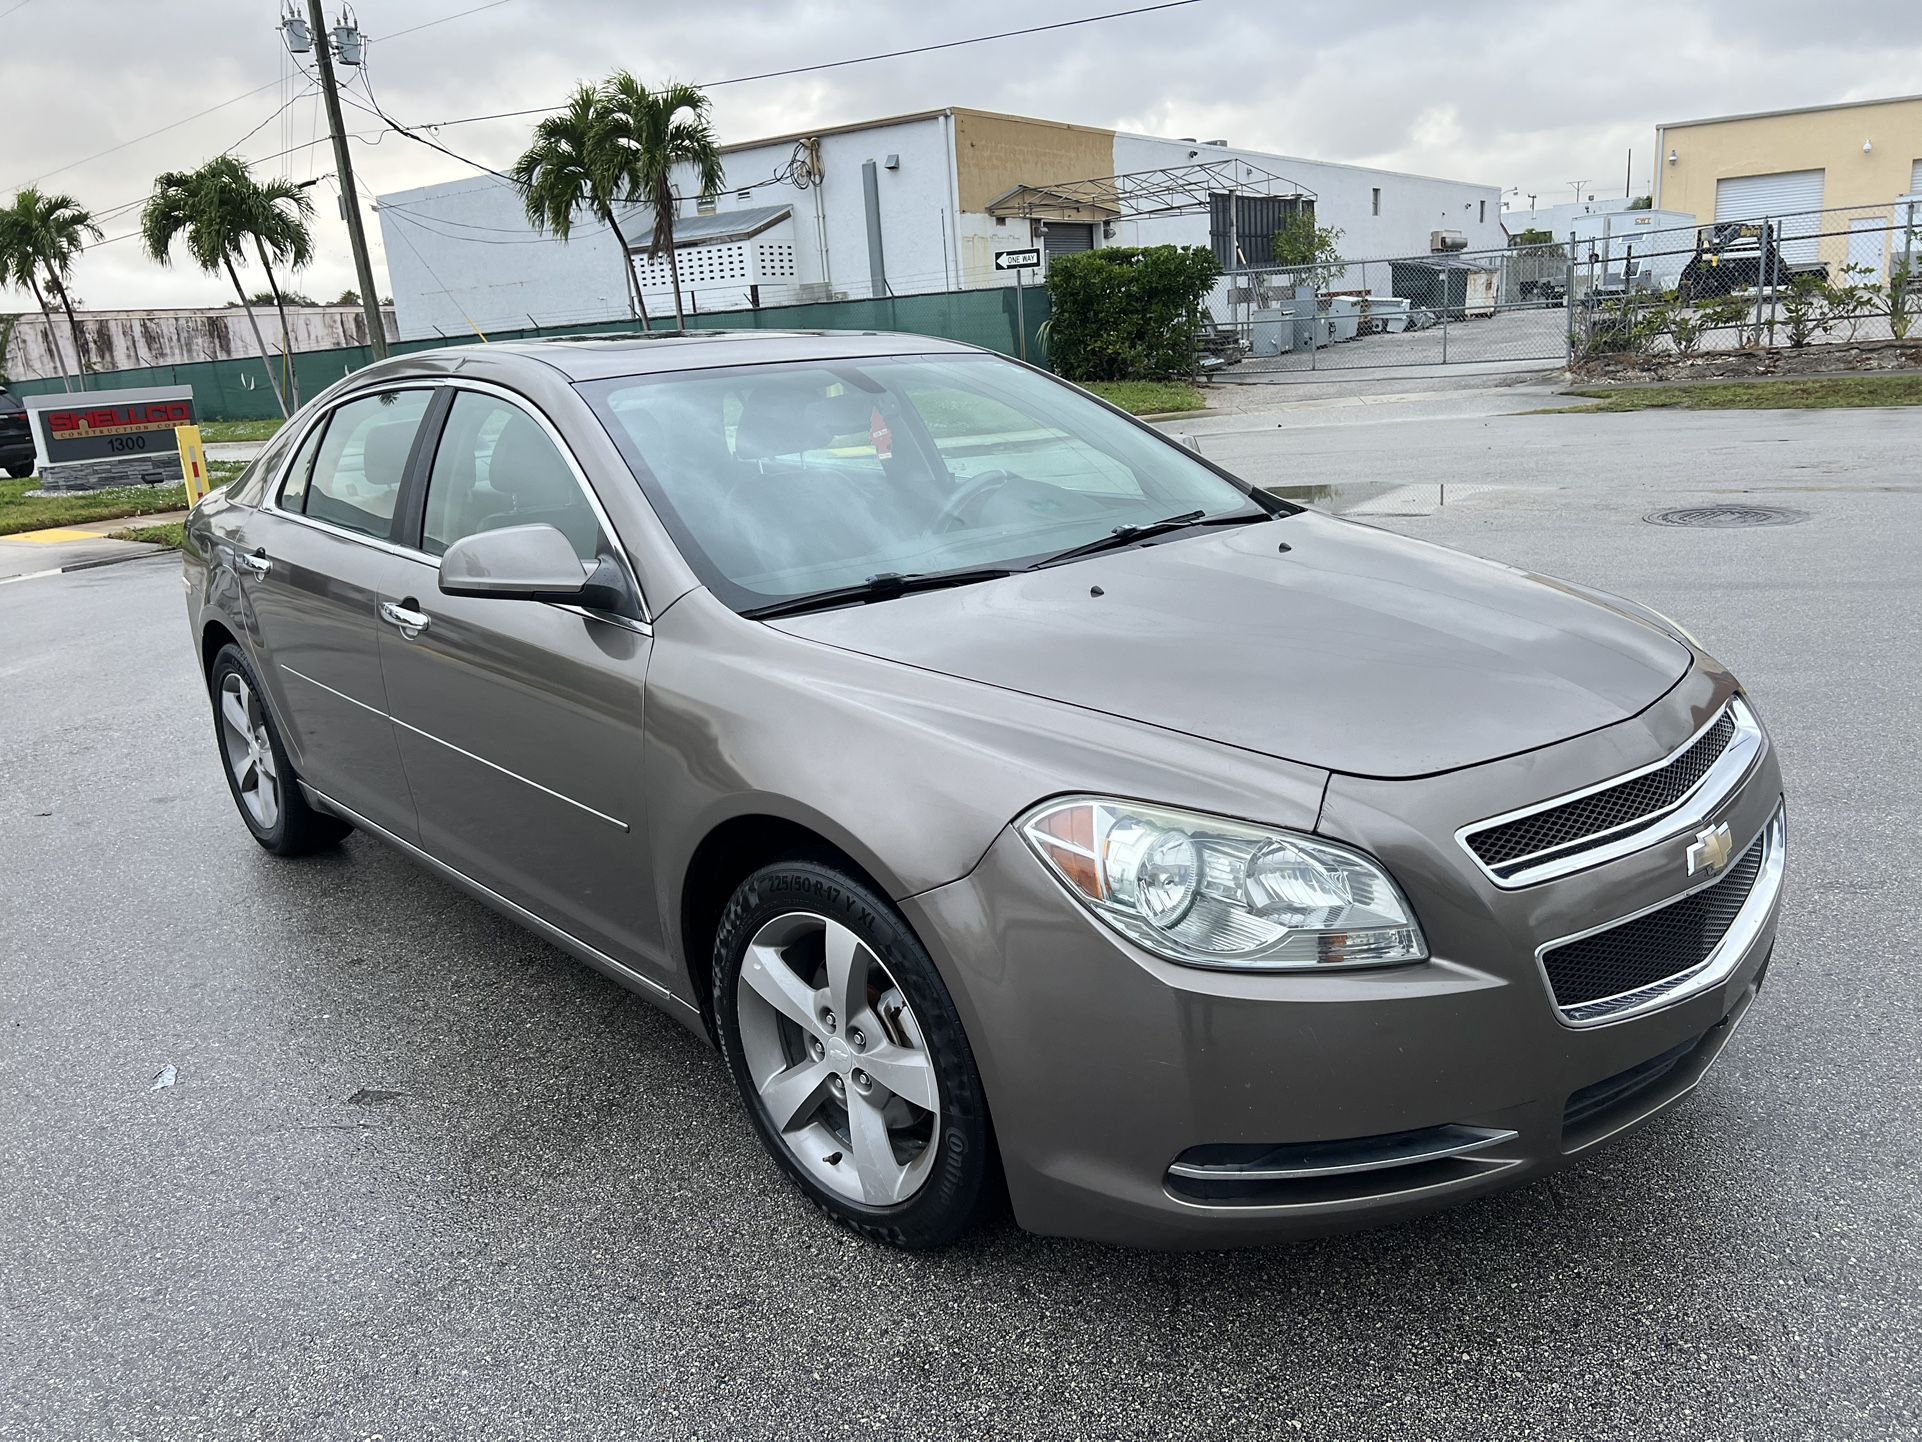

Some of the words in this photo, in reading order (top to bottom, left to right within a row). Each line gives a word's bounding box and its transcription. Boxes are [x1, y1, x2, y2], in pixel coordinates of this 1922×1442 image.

[1007, 255, 1020, 264] ONE
[1022, 254, 1035, 263] WAY
[48, 403, 189, 432] SHELLCO
[60, 425, 149, 438] CONSTRUCTION
[108, 436, 146, 452] 1300
[768, 874, 811, 893] 225/50
